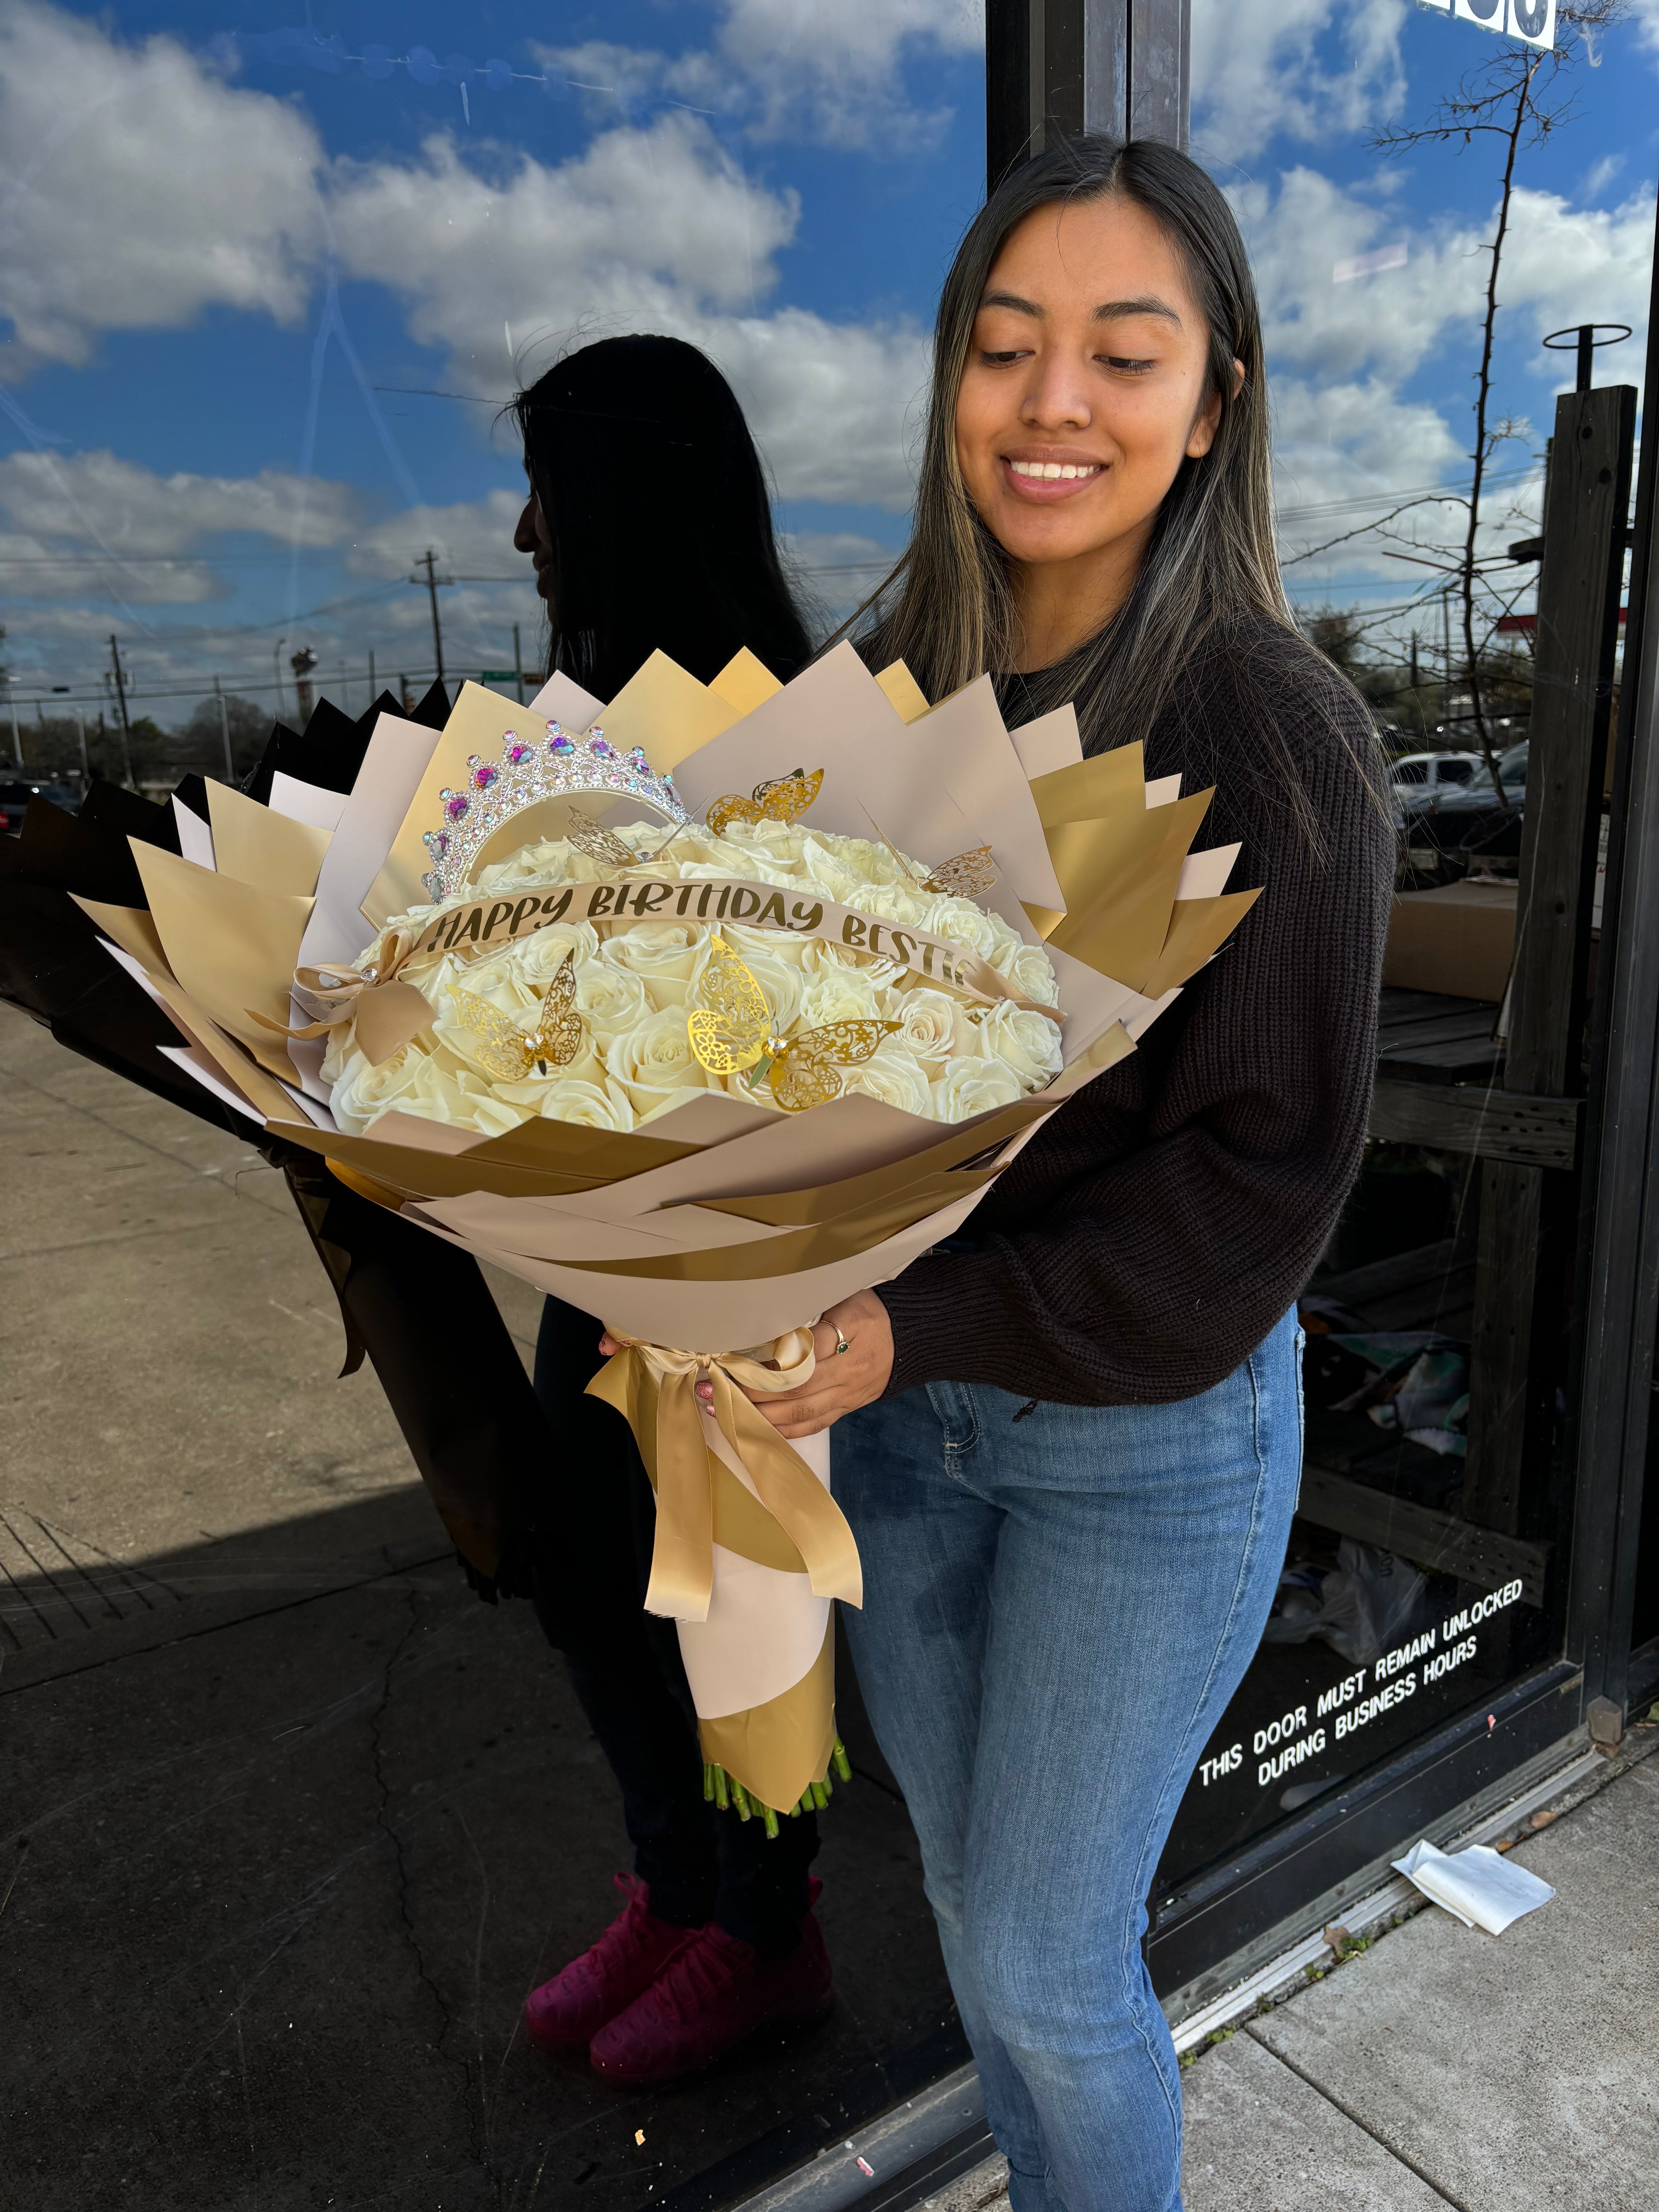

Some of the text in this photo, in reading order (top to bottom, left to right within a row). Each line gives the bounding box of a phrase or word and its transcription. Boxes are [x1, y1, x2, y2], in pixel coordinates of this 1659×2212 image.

[427, 889, 573, 953] HAPPY
[587, 883, 823, 931] BIRTHDAY
[1199, 1579, 1522, 1786] THIS DOOR MUST REMAIN UNLOCKED
[1258, 1635, 1477, 1786] DURING BUSINESS HOURS
